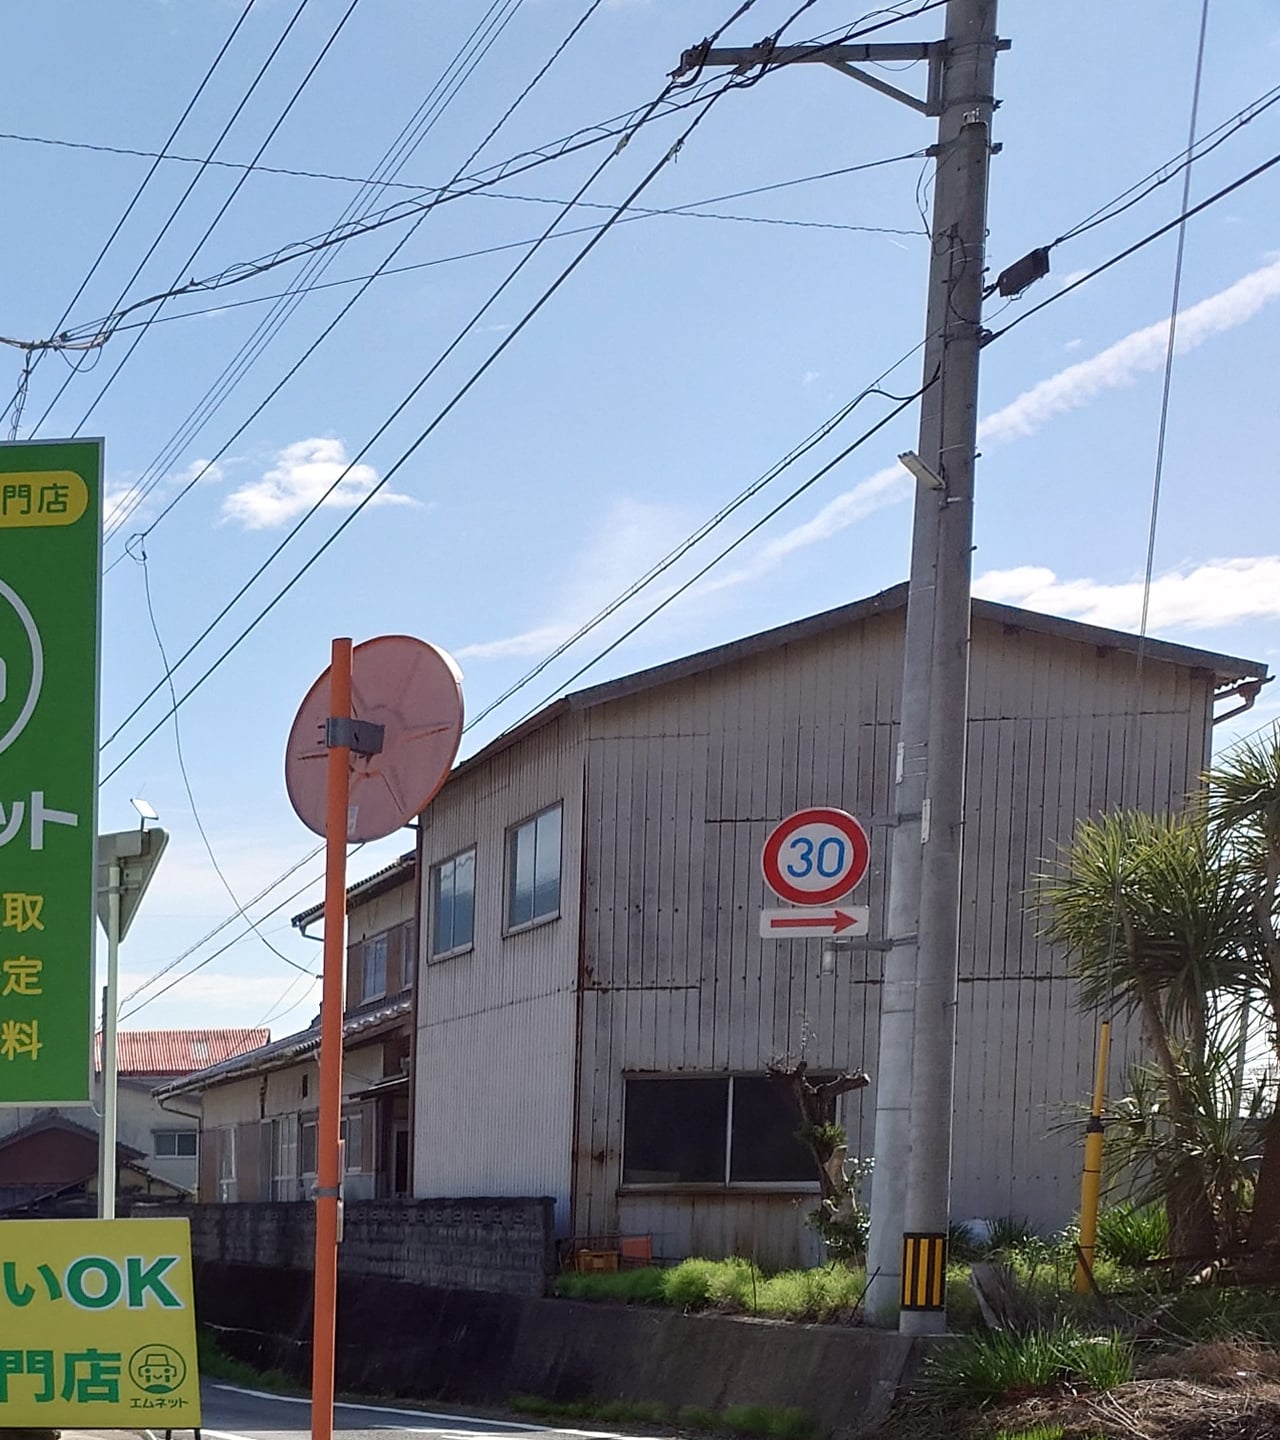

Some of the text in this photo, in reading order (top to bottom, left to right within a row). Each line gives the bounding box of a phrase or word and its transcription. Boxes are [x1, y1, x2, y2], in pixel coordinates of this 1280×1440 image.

[787, 837, 845, 878] 30
[130, 1397, 189, 1409] エムネット
